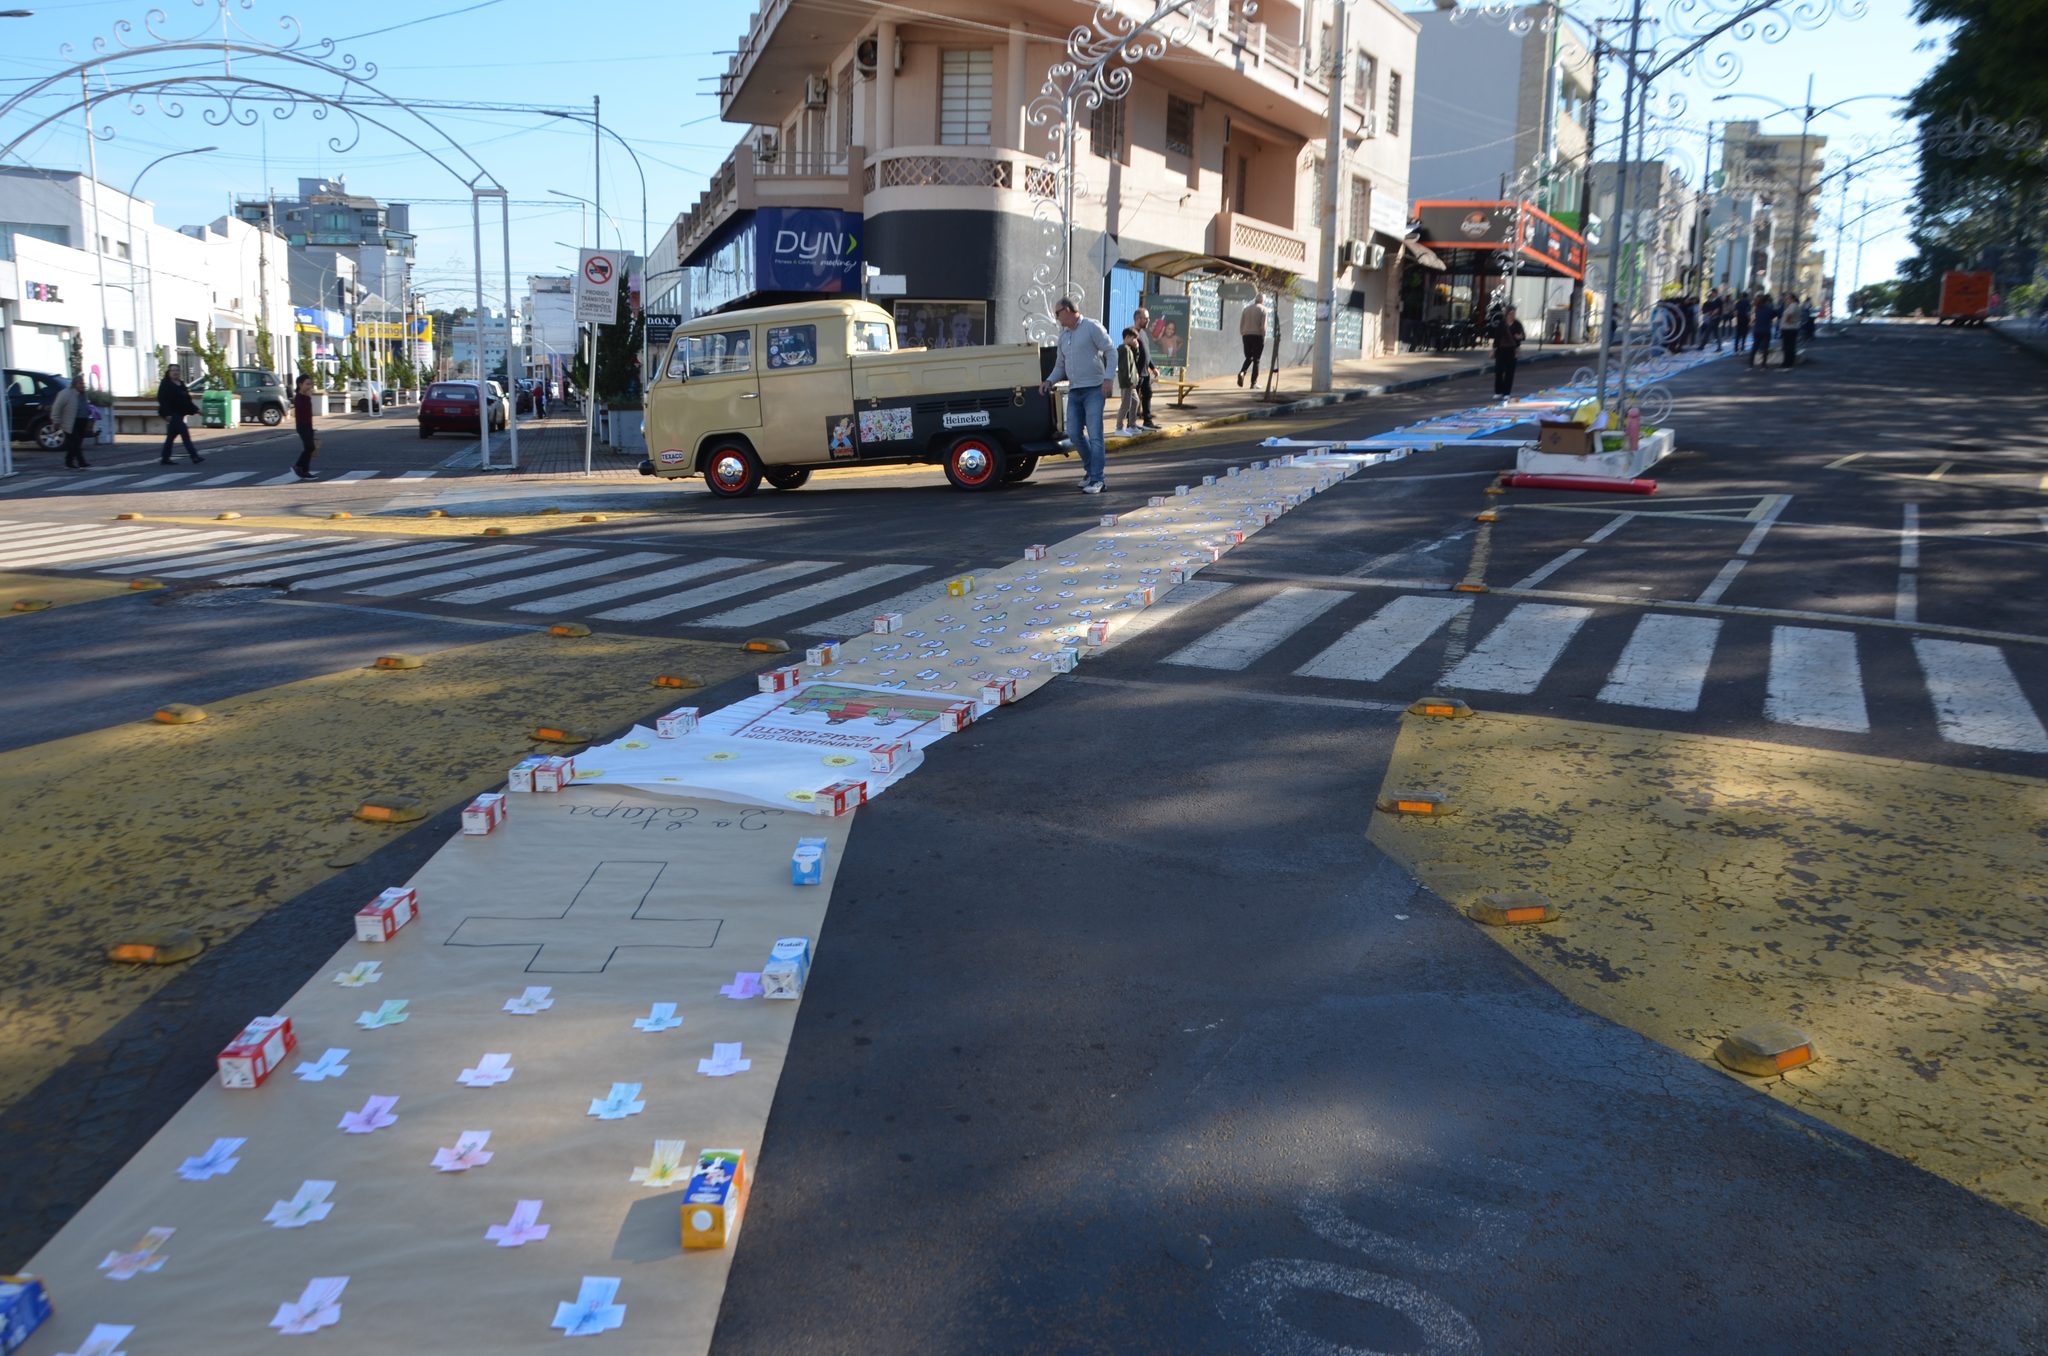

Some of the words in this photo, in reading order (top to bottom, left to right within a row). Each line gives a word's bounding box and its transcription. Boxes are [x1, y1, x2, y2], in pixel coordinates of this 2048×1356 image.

[775, 230, 844, 259] DYN
[945, 415, 987, 425] Heineken
[742, 732, 775, 741] COM
[750, 725, 817, 737] CRISTO
[818, 732, 880, 742] JESUS
[776, 736, 873, 749] CAMINHANDO
[559, 800, 699, 831] Etapa
